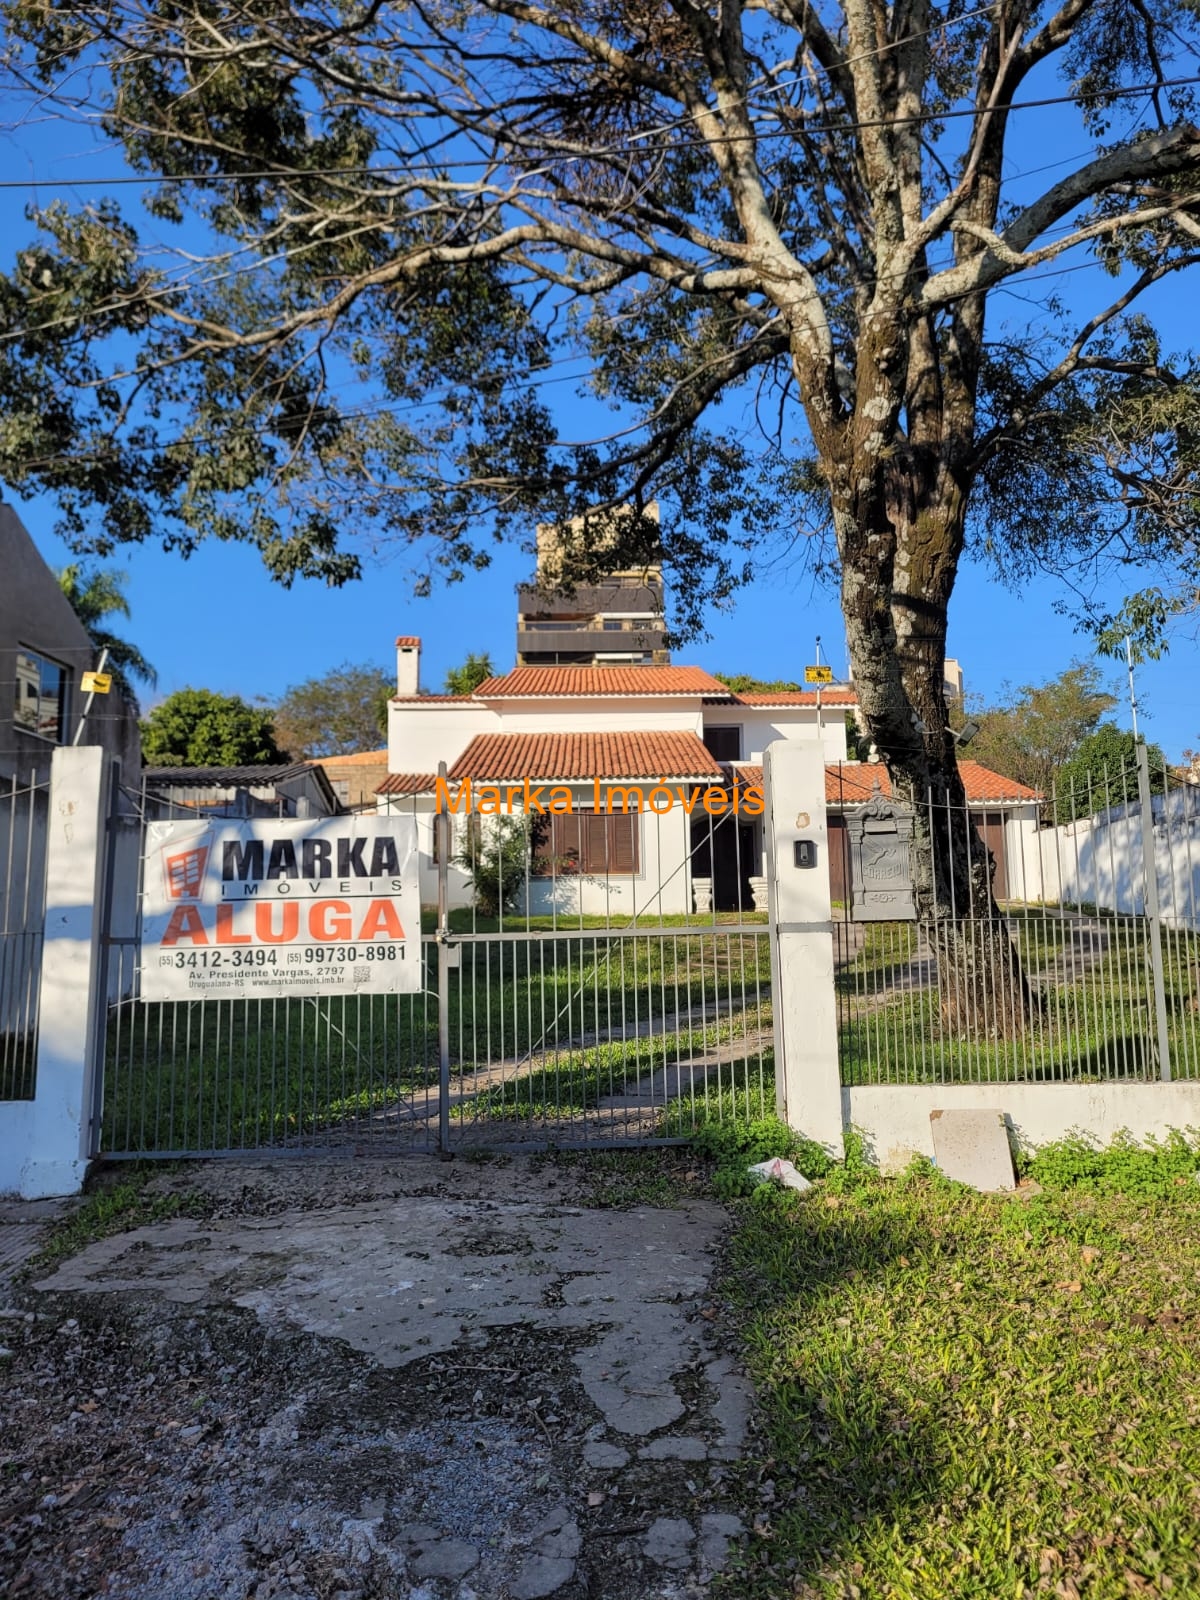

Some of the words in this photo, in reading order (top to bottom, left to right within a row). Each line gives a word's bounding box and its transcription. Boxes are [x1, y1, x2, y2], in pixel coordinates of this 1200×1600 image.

[222, 836, 400, 881] MARKA
[222, 880, 402, 896] IMÓVEIS
[160, 899, 406, 945] ALUGA
[159, 955, 174, 968] (55)
[175, 949, 278, 969] 3412-3494
[287, 953, 302, 965] (55)
[304, 945, 406, 963] 99730-8981
[189, 971, 205, 979] Av.
[209, 968, 269, 979] Presidente
[272, 968, 314, 979] Vargas,
[317, 966, 345, 976] 2797
[189, 978, 245, 989] Uruguaiana-RS
[252, 975, 345, 987] www.markaimoveis.imb.br
